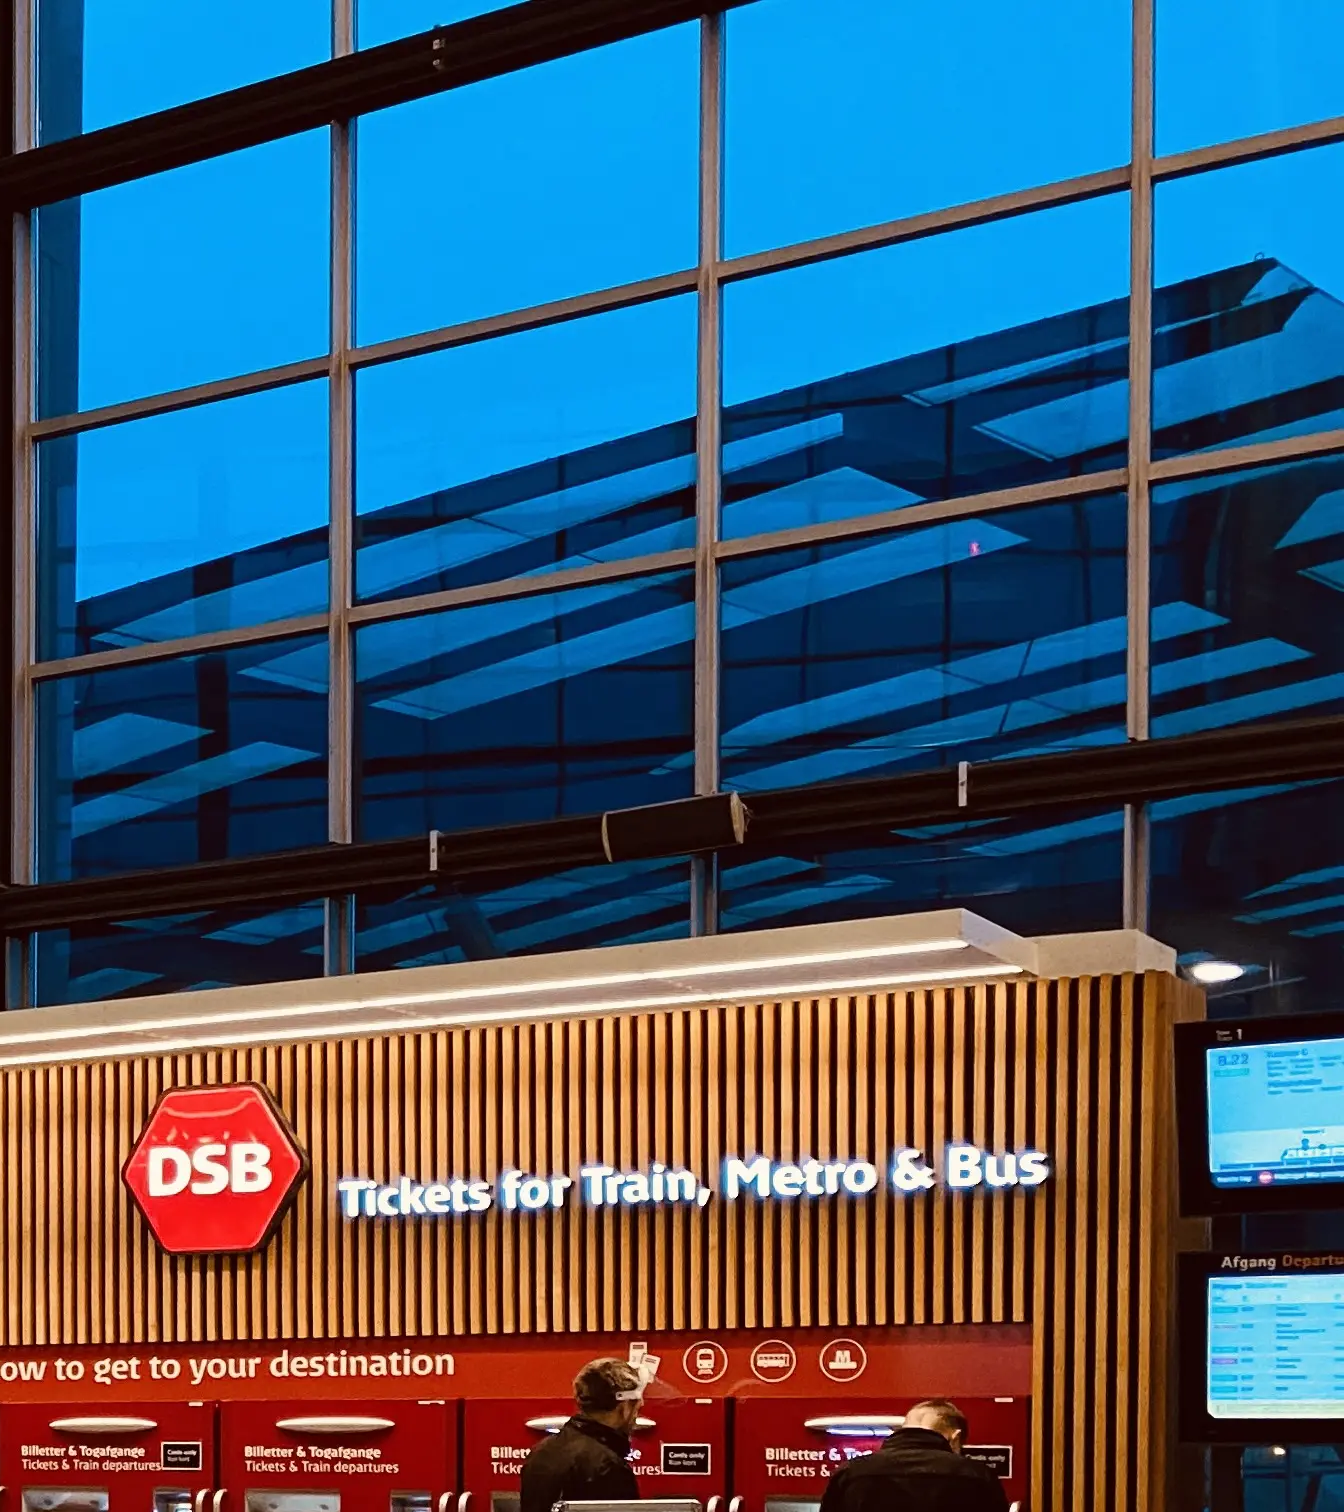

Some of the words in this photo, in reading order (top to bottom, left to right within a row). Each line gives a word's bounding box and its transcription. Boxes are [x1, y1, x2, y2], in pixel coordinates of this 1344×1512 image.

[147, 1141, 273, 1197] DSB
[339, 1176, 493, 1218] Tickets
[501, 1169, 572, 1210] for
[581, 1163, 712, 1208] Train,
[725, 1156, 877, 1198] Metro
[892, 1147, 935, 1191] &
[947, 1144, 1050, 1187] Bus
[1220, 1256, 1277, 1271] Afgang
[1282, 1254, 1344, 1270] Departu
[53, 1358, 85, 1381] to
[93, 1357, 141, 1385] get
[148, 1357, 181, 1380] to
[188, 1357, 262, 1385] your
[269, 1348, 455, 1378] destination
[21, 1445, 66, 1456] Billetter
[68, 1445, 77, 1456] &
[244, 1446, 294, 1458] Billetter
[296, 1446, 306, 1458] &
[765, 1447, 826, 1461] Billetter
[828, 1447, 841, 1460] &
[22, 1459, 59, 1470] Tickets
[61, 1459, 70, 1470] &
[73, 1459, 99, 1470] Train
[102, 1459, 162, 1472] departures
[245, 1460, 285, 1473] Tickets
[288, 1460, 299, 1473] &
[301, 1460, 330, 1473] Train
[333, 1460, 400, 1475] departures
[766, 1464, 816, 1477] Tickets
[819, 1464, 831, 1477] &
